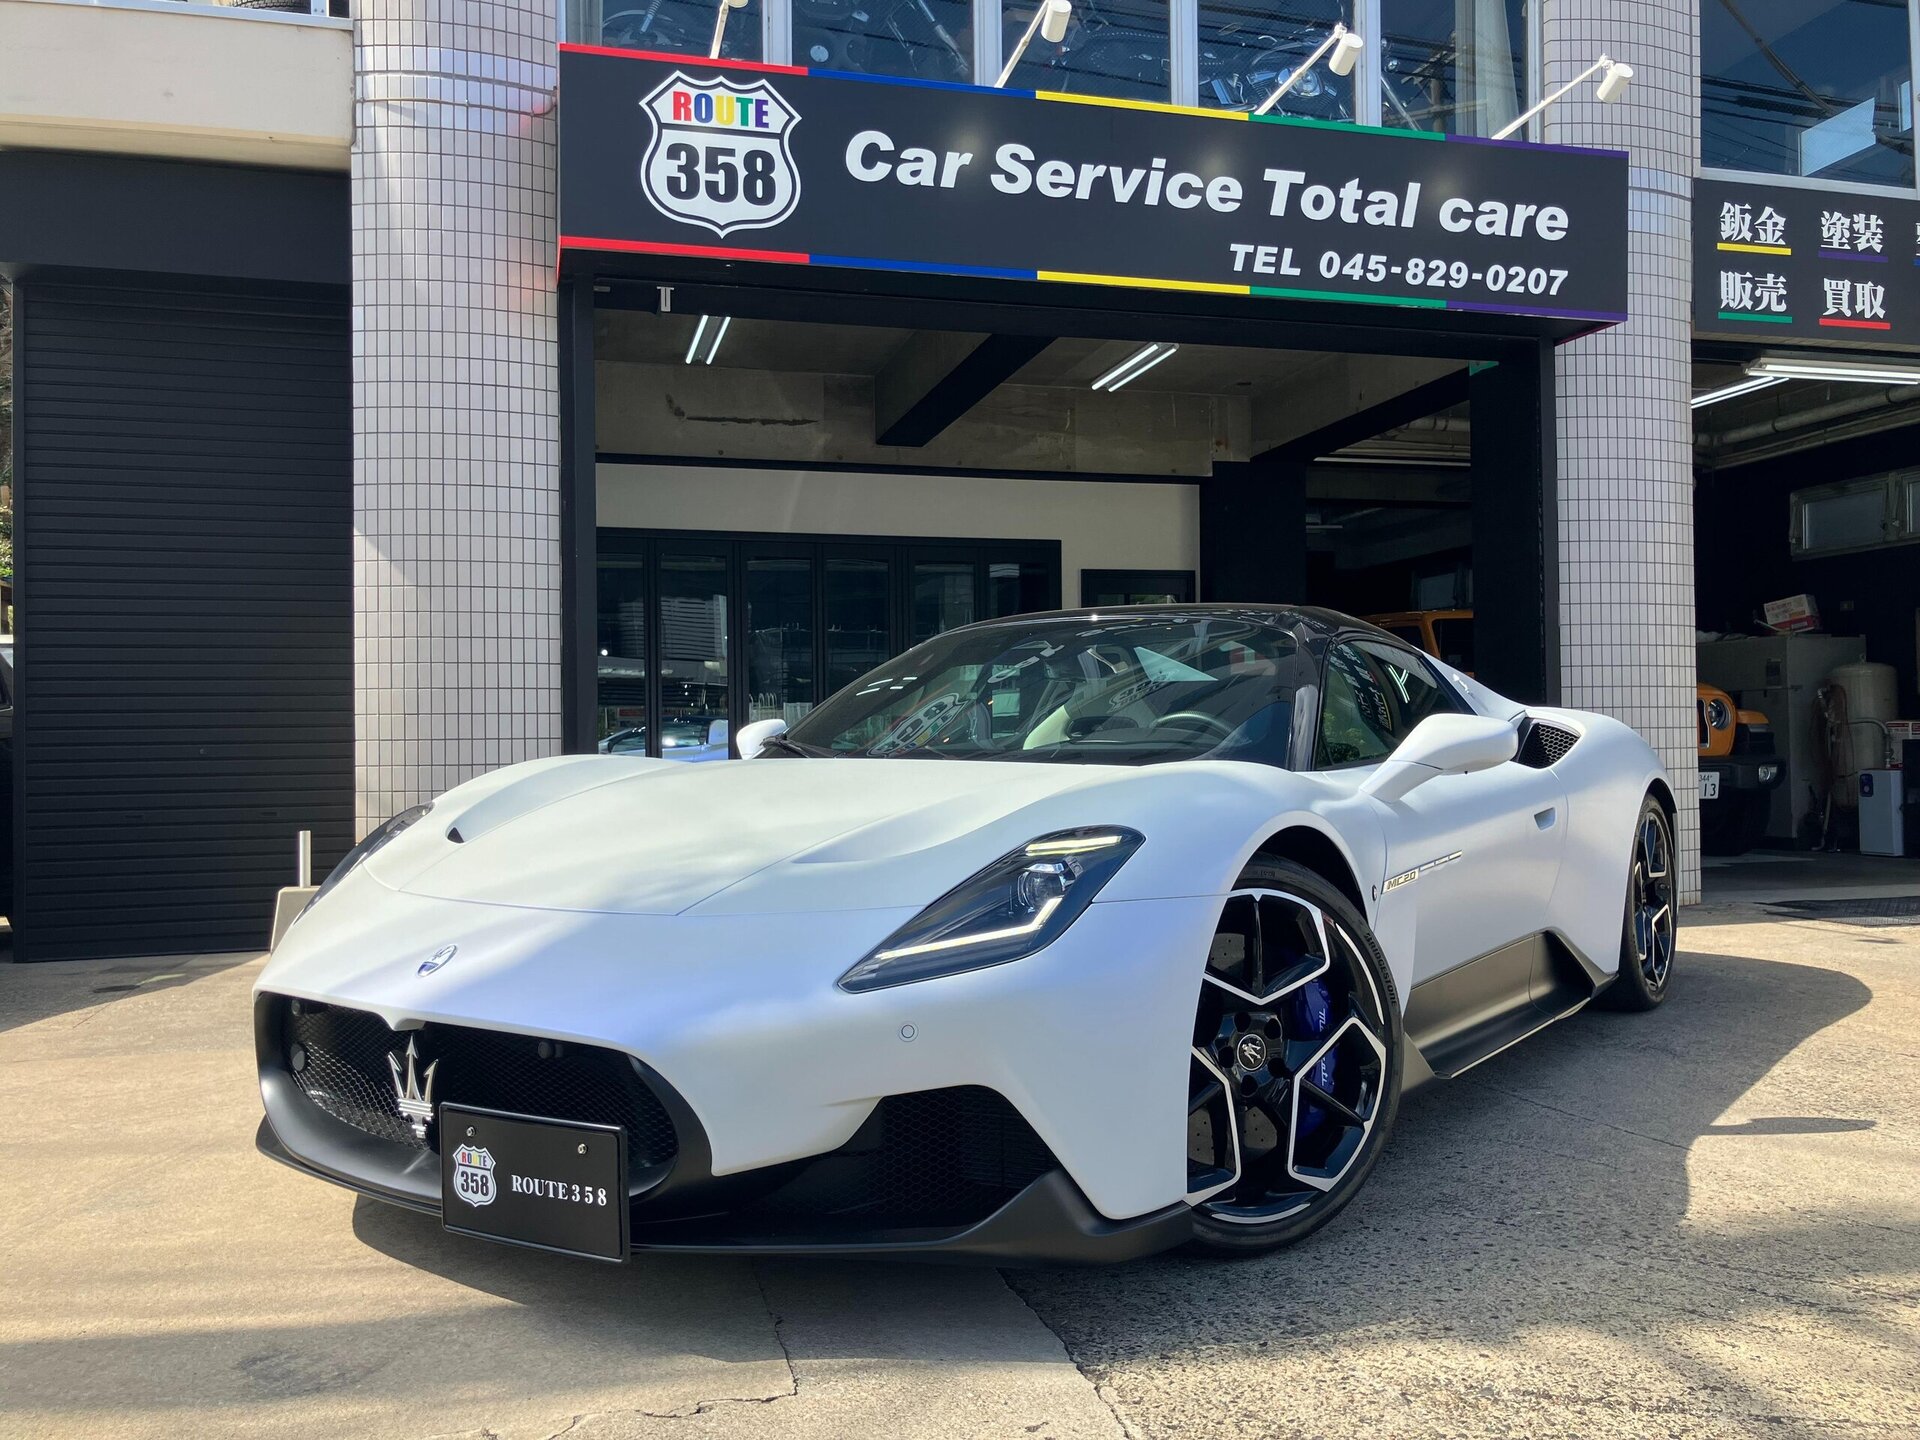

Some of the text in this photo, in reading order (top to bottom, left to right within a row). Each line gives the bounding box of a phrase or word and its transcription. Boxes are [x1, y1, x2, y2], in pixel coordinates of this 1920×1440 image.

[673, 91, 769, 128] ROUTE
[666, 143, 776, 206] 358
[846, 130, 1569, 241] Car Service Total care
[1720, 202, 1787, 246] 鈑金
[1820, 211, 1884, 253] 塗装
[1230, 244, 1569, 296] TEL 045-829-0207
[1720, 271, 1886, 319] 販売 買取
[1386, 871, 1417, 890] MC20
[461, 1152, 487, 1167] ROUTE
[461, 1170, 489, 1197] 358
